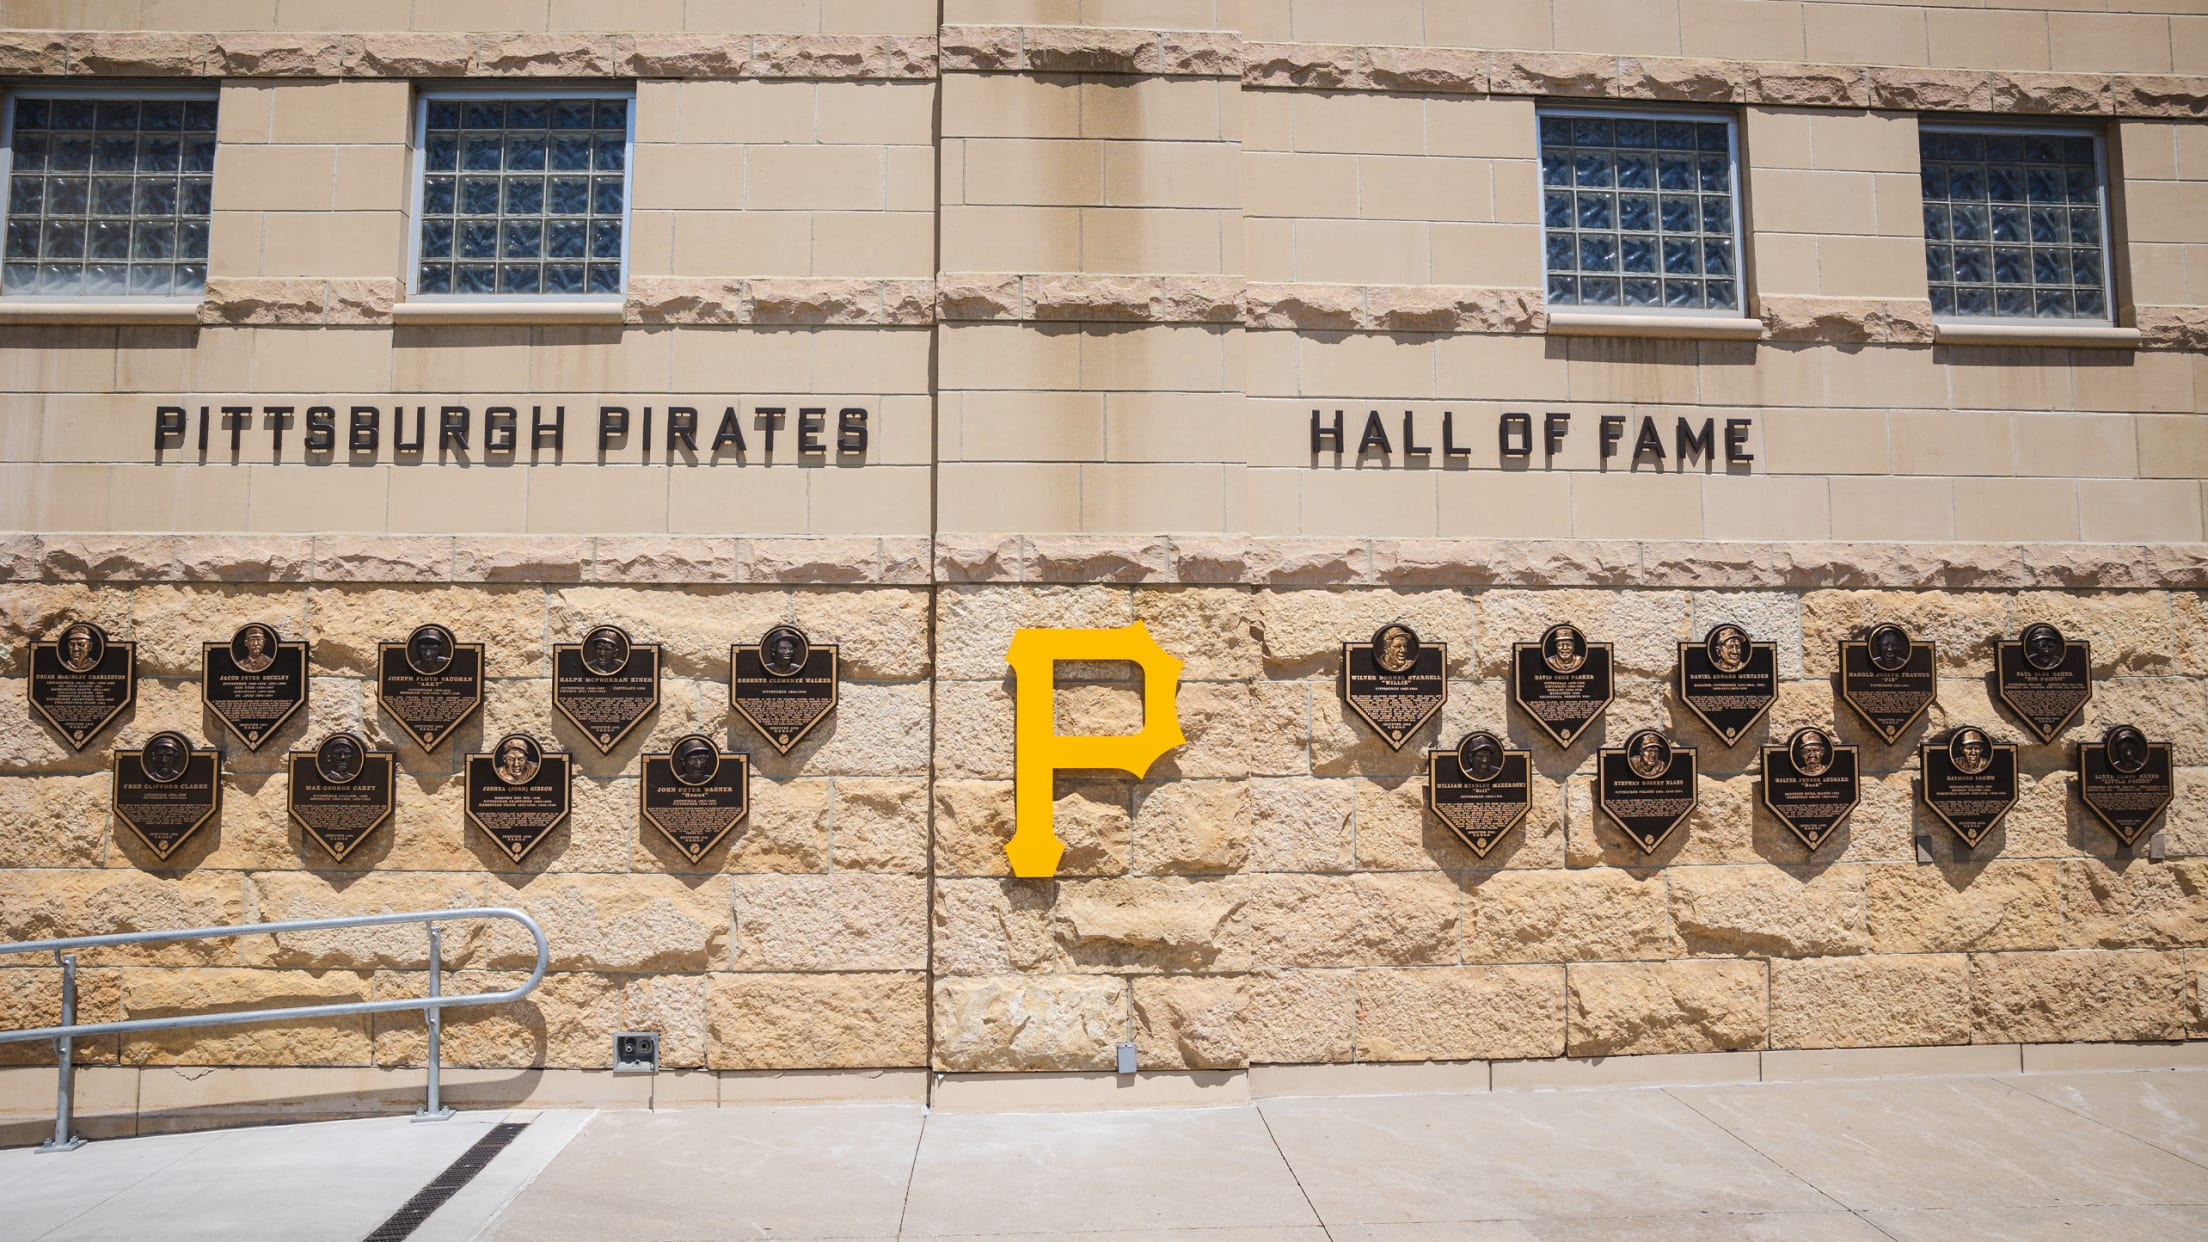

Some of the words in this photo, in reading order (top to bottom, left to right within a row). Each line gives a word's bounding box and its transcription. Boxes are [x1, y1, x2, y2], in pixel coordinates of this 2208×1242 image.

[155, 406, 566, 451] PITTSBURGH
[600, 406, 869, 454] PIRATES
[1311, 409, 1471, 456] HALL
[1500, 412, 1571, 455] OF
[1600, 415, 1755, 461] FAME
[1003, 619, 1186, 878] P
